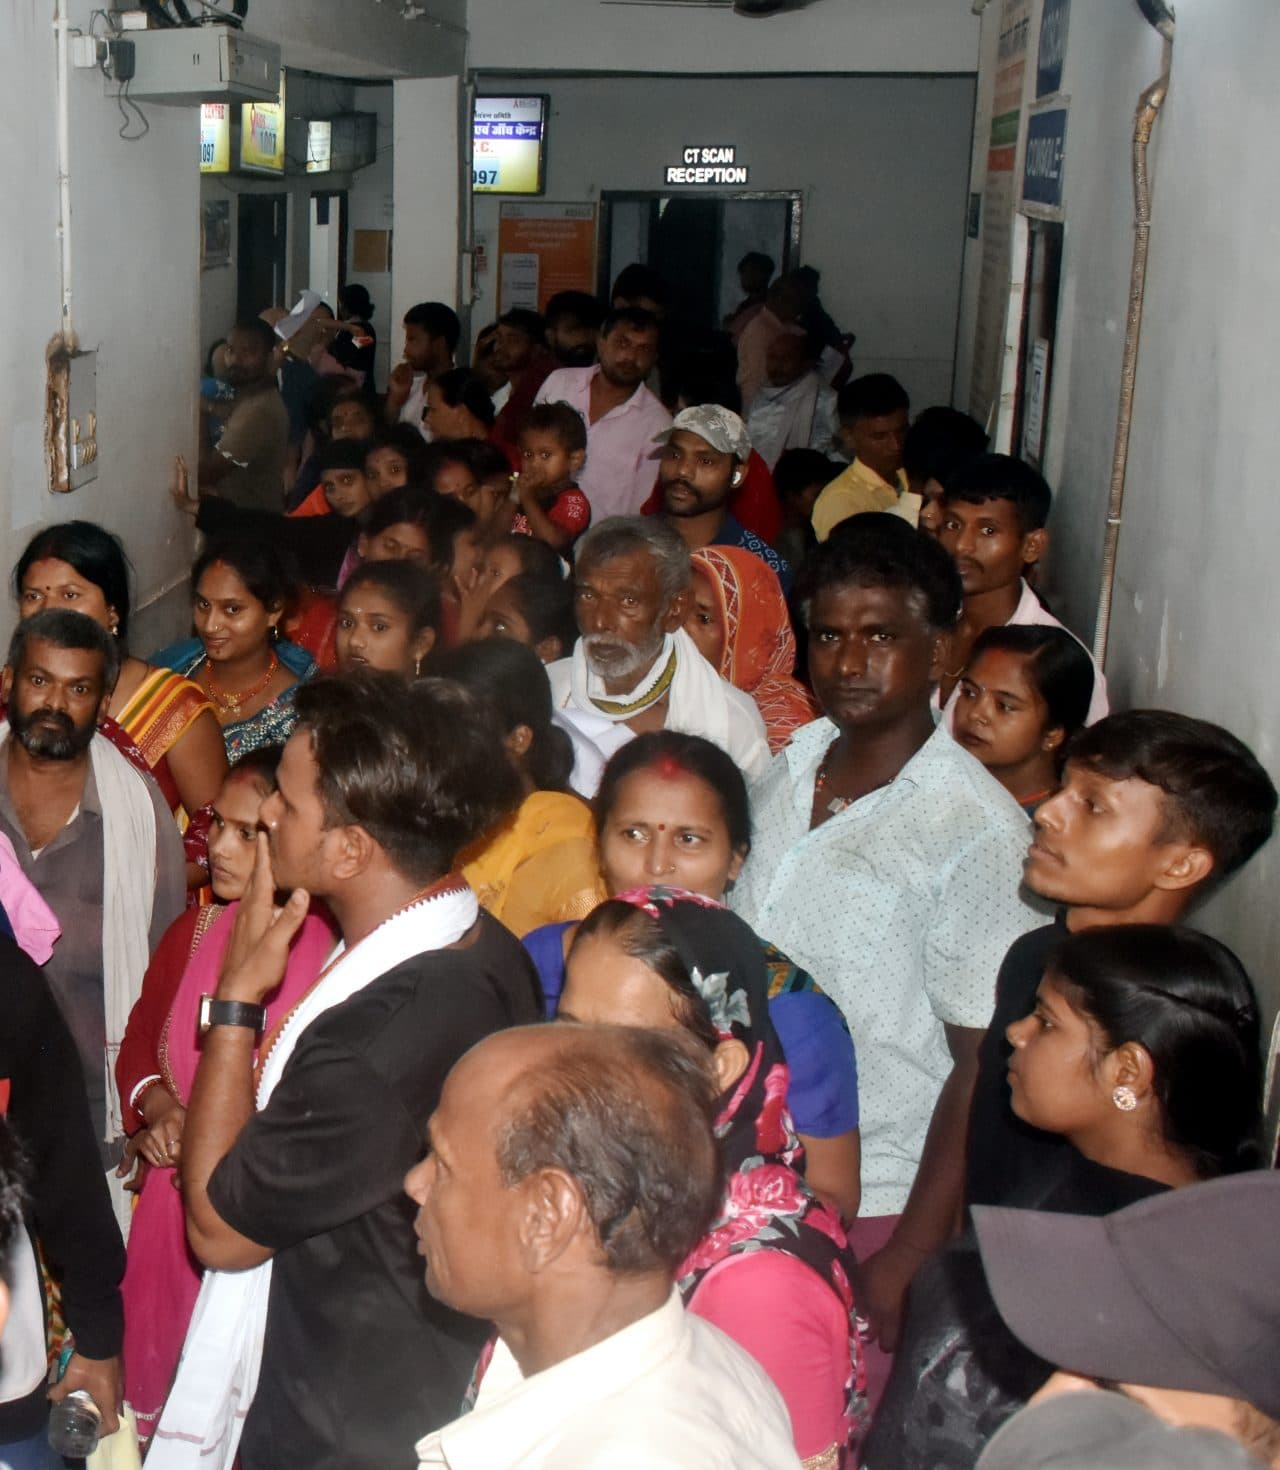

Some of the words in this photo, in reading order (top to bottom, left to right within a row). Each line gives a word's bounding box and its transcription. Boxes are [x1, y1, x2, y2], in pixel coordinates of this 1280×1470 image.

[684, 148, 701, 164] CT
[701, 148, 734, 164] SCAN
[667, 167, 747, 183] RECEPTION
